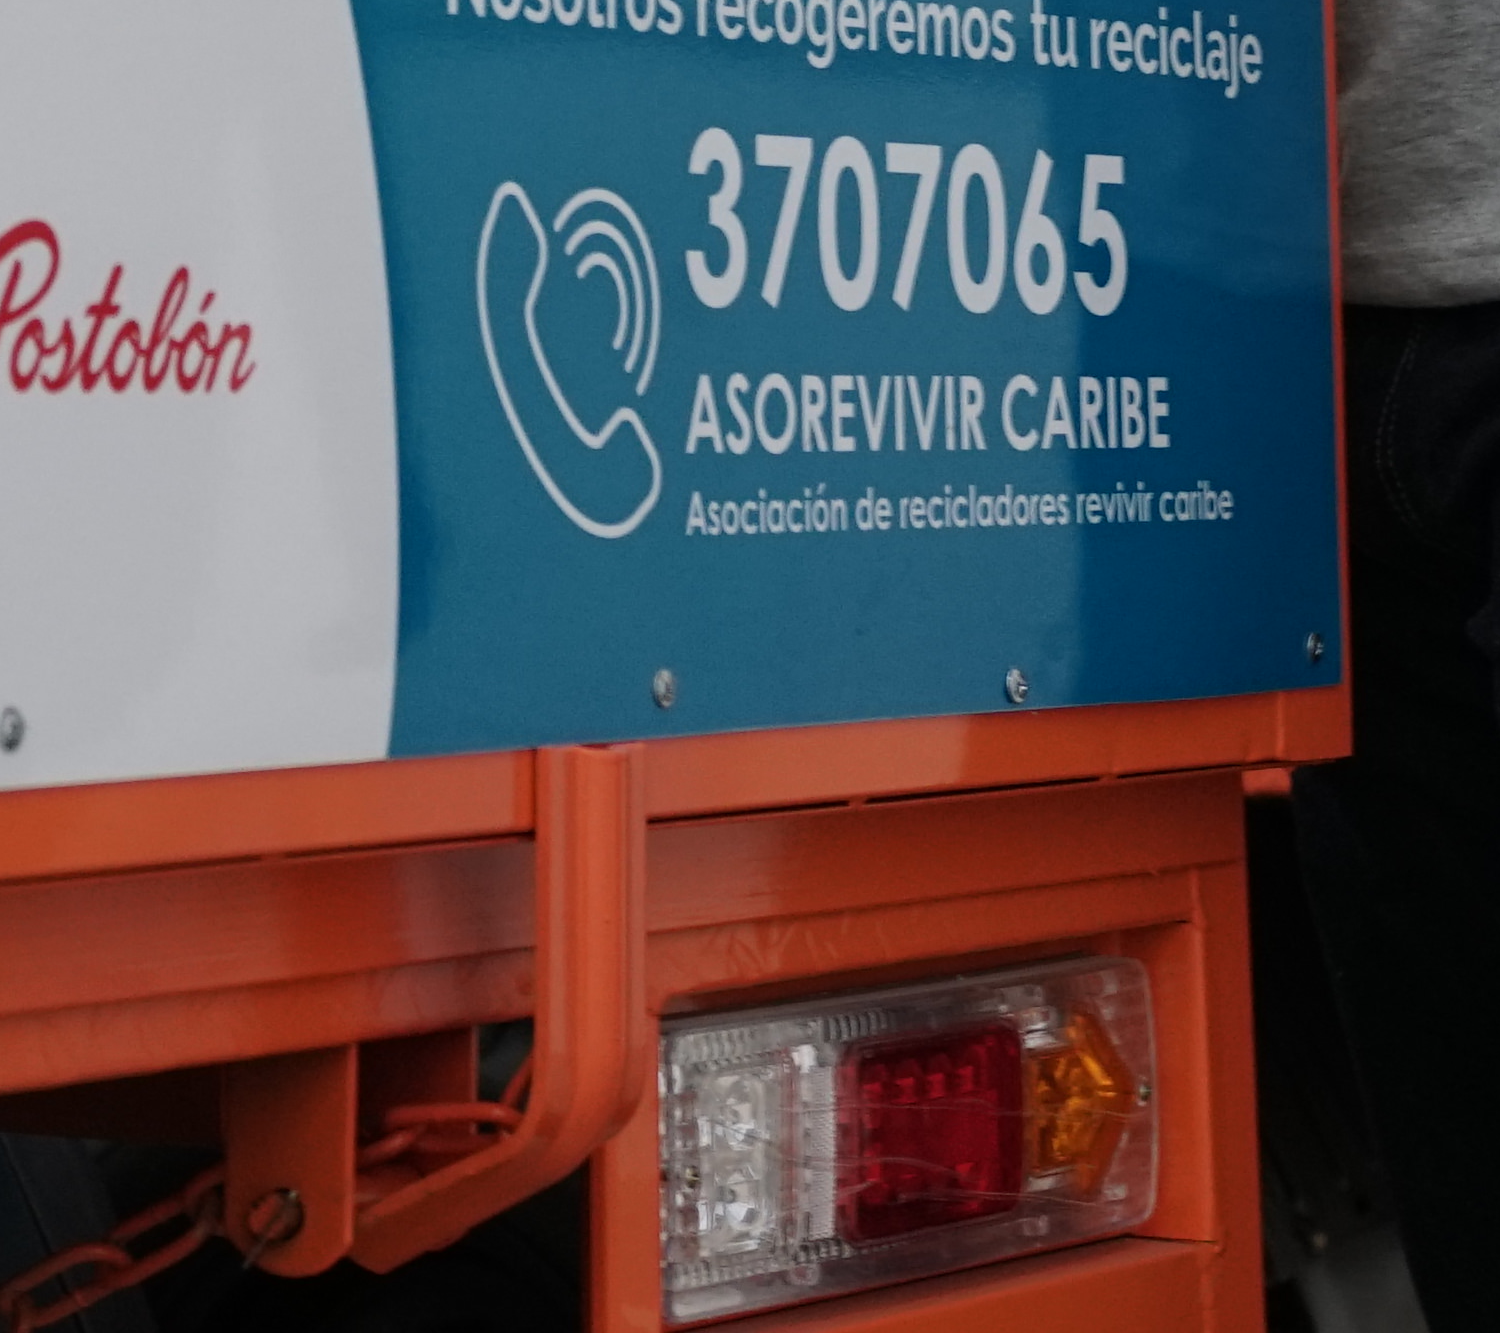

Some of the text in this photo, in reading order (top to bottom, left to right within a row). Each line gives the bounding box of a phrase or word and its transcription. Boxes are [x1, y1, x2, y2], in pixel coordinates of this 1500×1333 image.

[1090, 7, 1263, 98] reciclaje
[685, 127, 1128, 316] 3707065
[685, 372, 1171, 454] ASOREVIVIR CARIBE
[685, 480, 1235, 535] Asociación de recicladores revivir caribe
